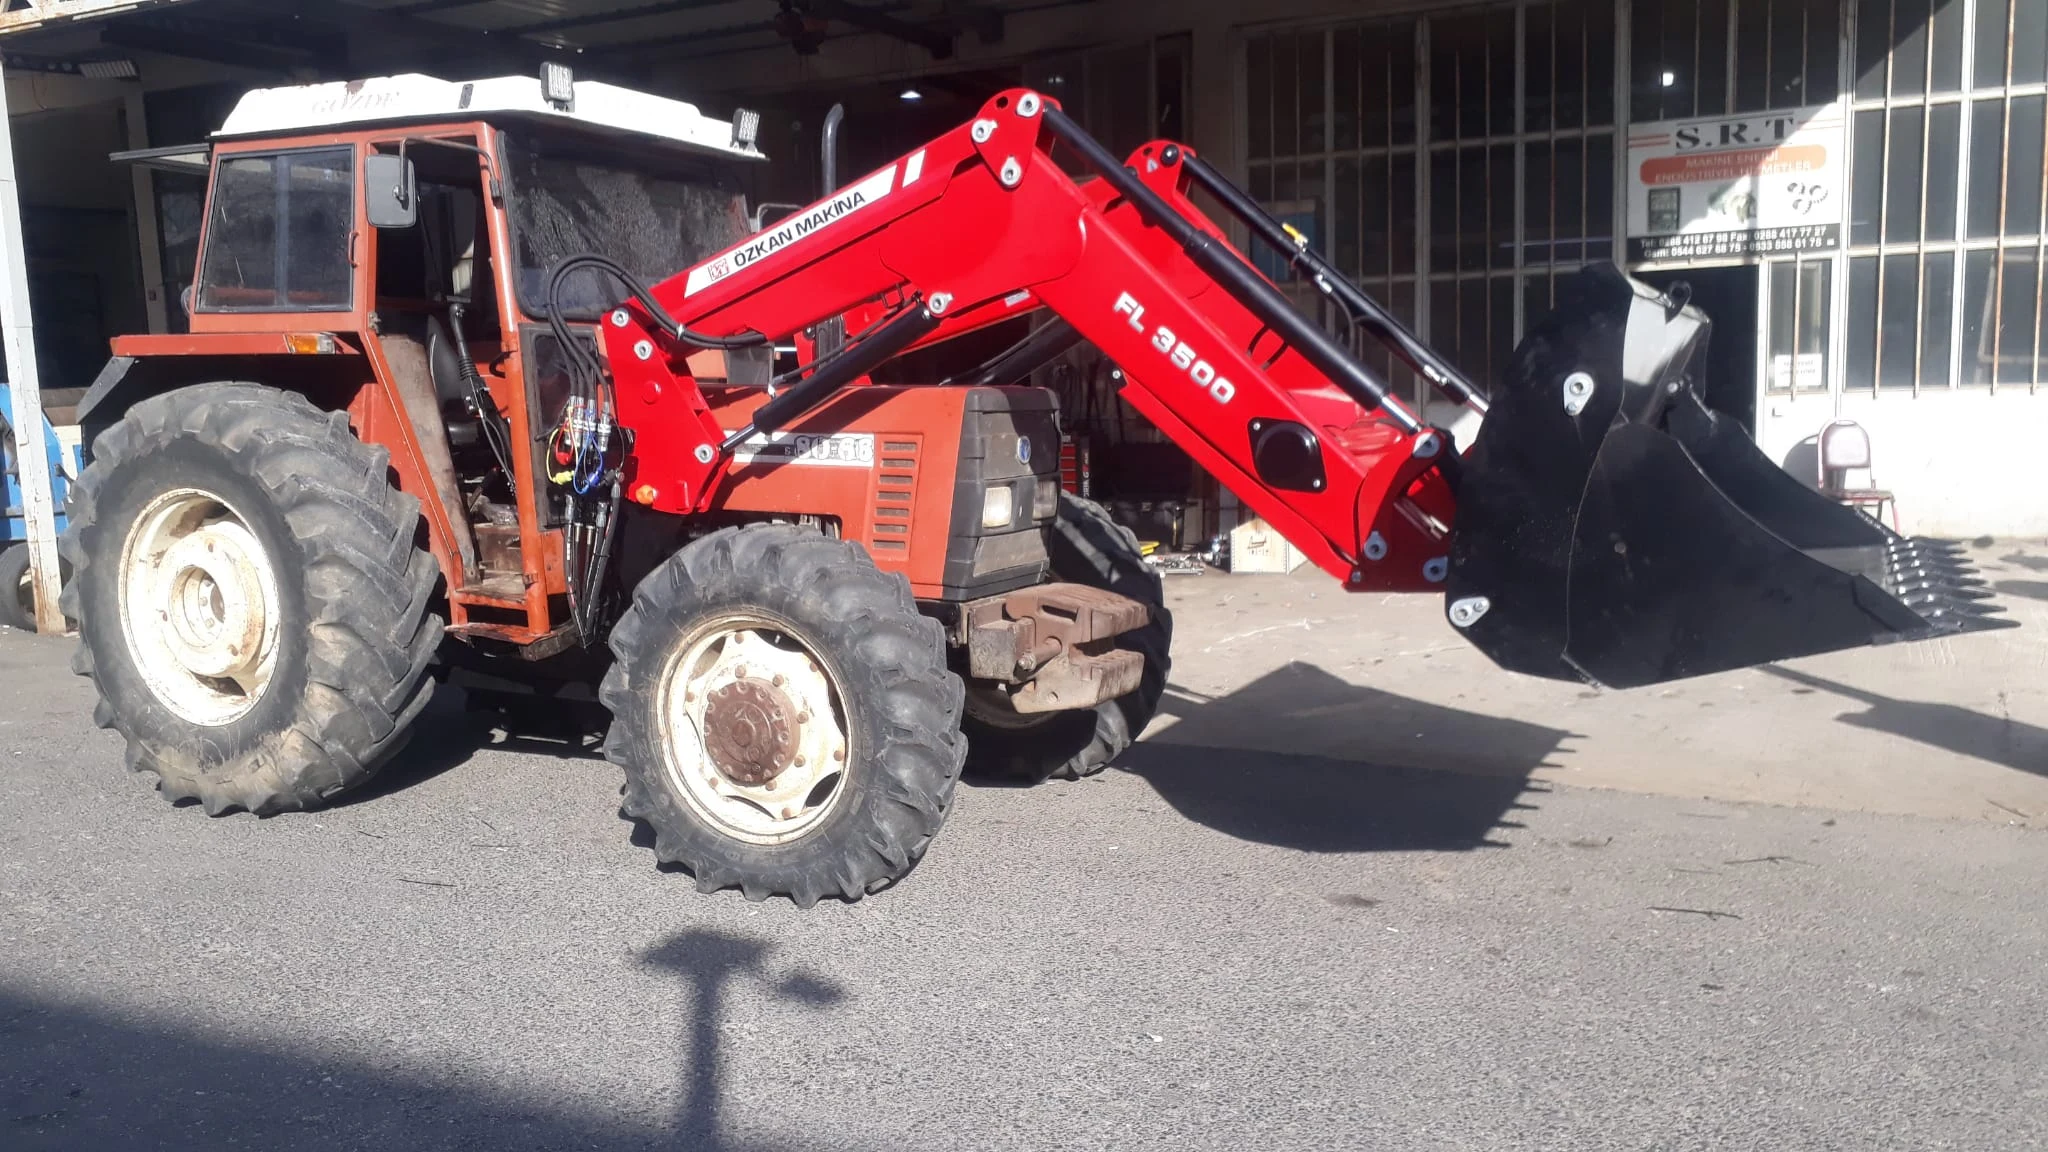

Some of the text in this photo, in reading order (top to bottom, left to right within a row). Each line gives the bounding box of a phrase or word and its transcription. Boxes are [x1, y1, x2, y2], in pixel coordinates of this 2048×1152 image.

[1675, 117, 1795, 149] S.R.T
[734, 191, 866, 267] ÖZKAN MAKİNA
[1779, 227, 1797, 239] 417
[1800, 225, 1812, 238] 77
[1113, 290, 1236, 405] FL 3500
